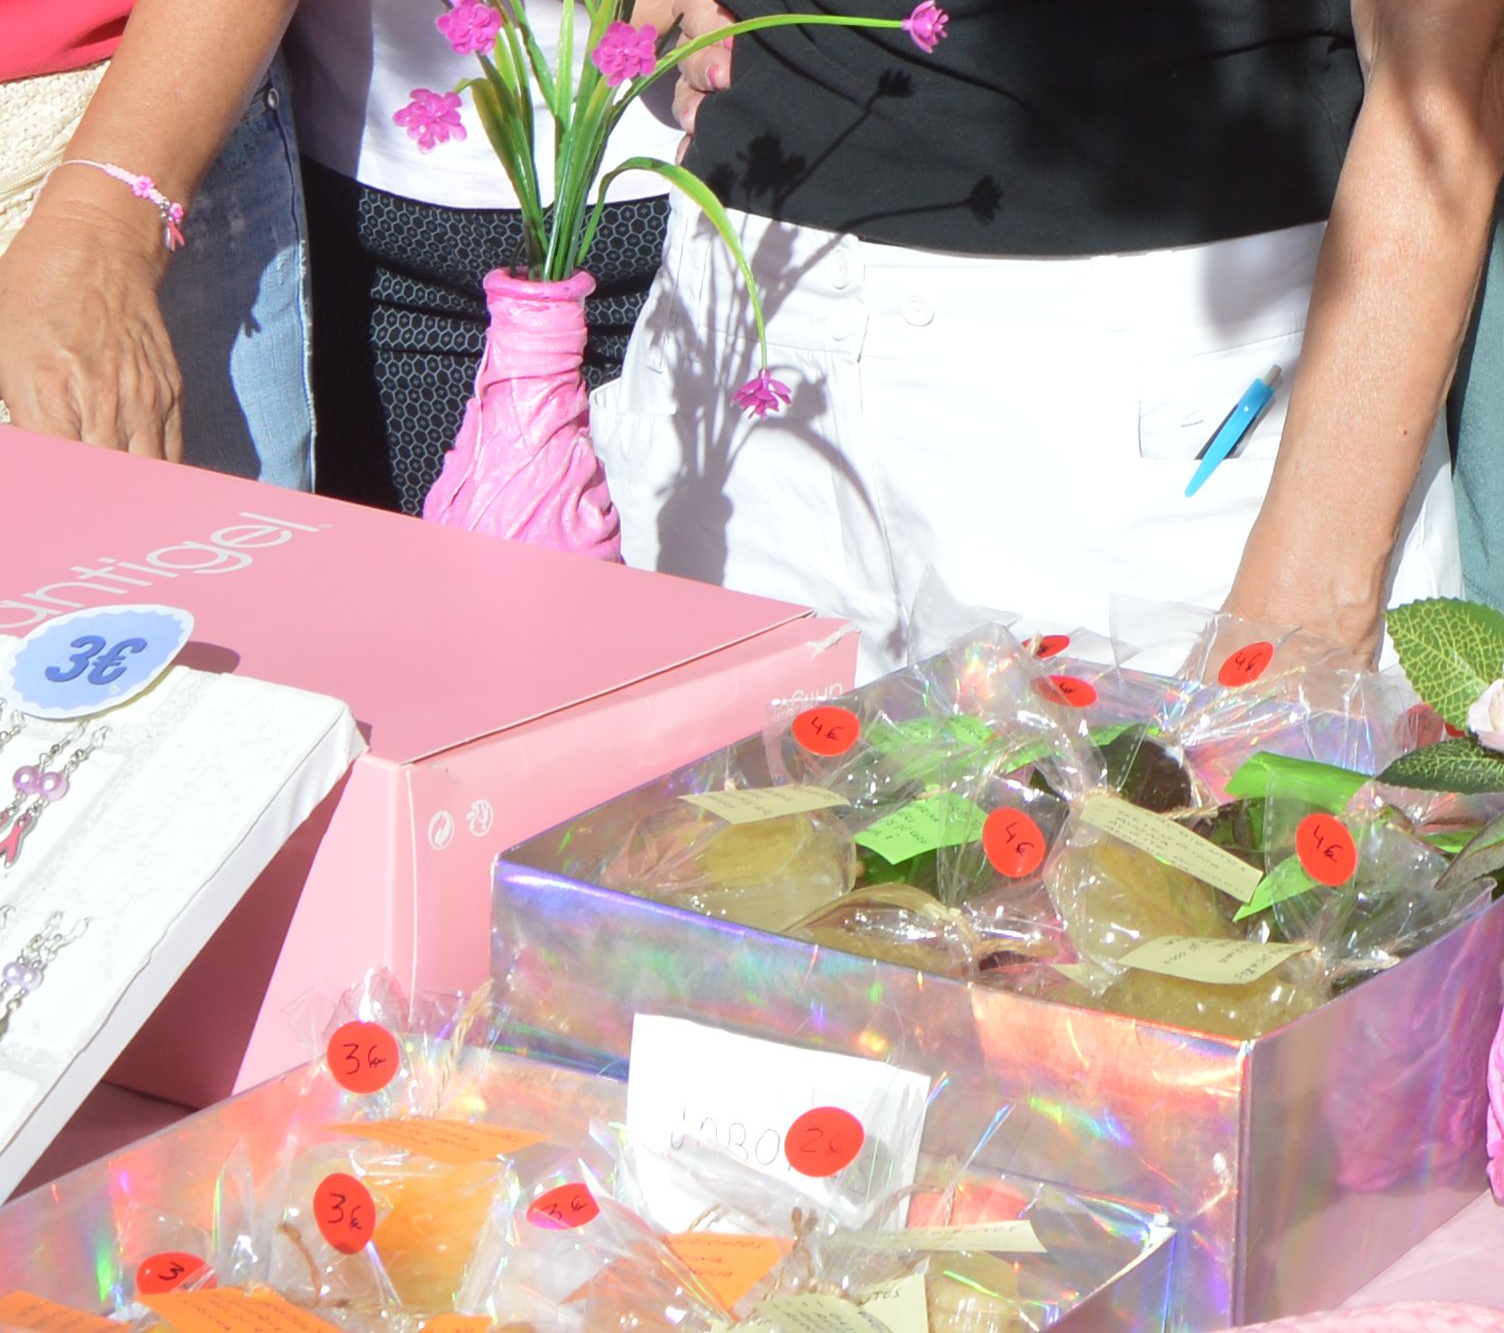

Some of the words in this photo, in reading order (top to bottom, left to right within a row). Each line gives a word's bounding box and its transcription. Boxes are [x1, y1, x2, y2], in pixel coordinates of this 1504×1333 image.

[45, 635, 148, 685] 3€
[811, 716, 843, 741] 4€
[1004, 821, 1035, 855] 4€
[1313, 824, 1344, 863] 4€
[342, 1043, 386, 1073] 3€
[326, 1192, 363, 1231] 3€
